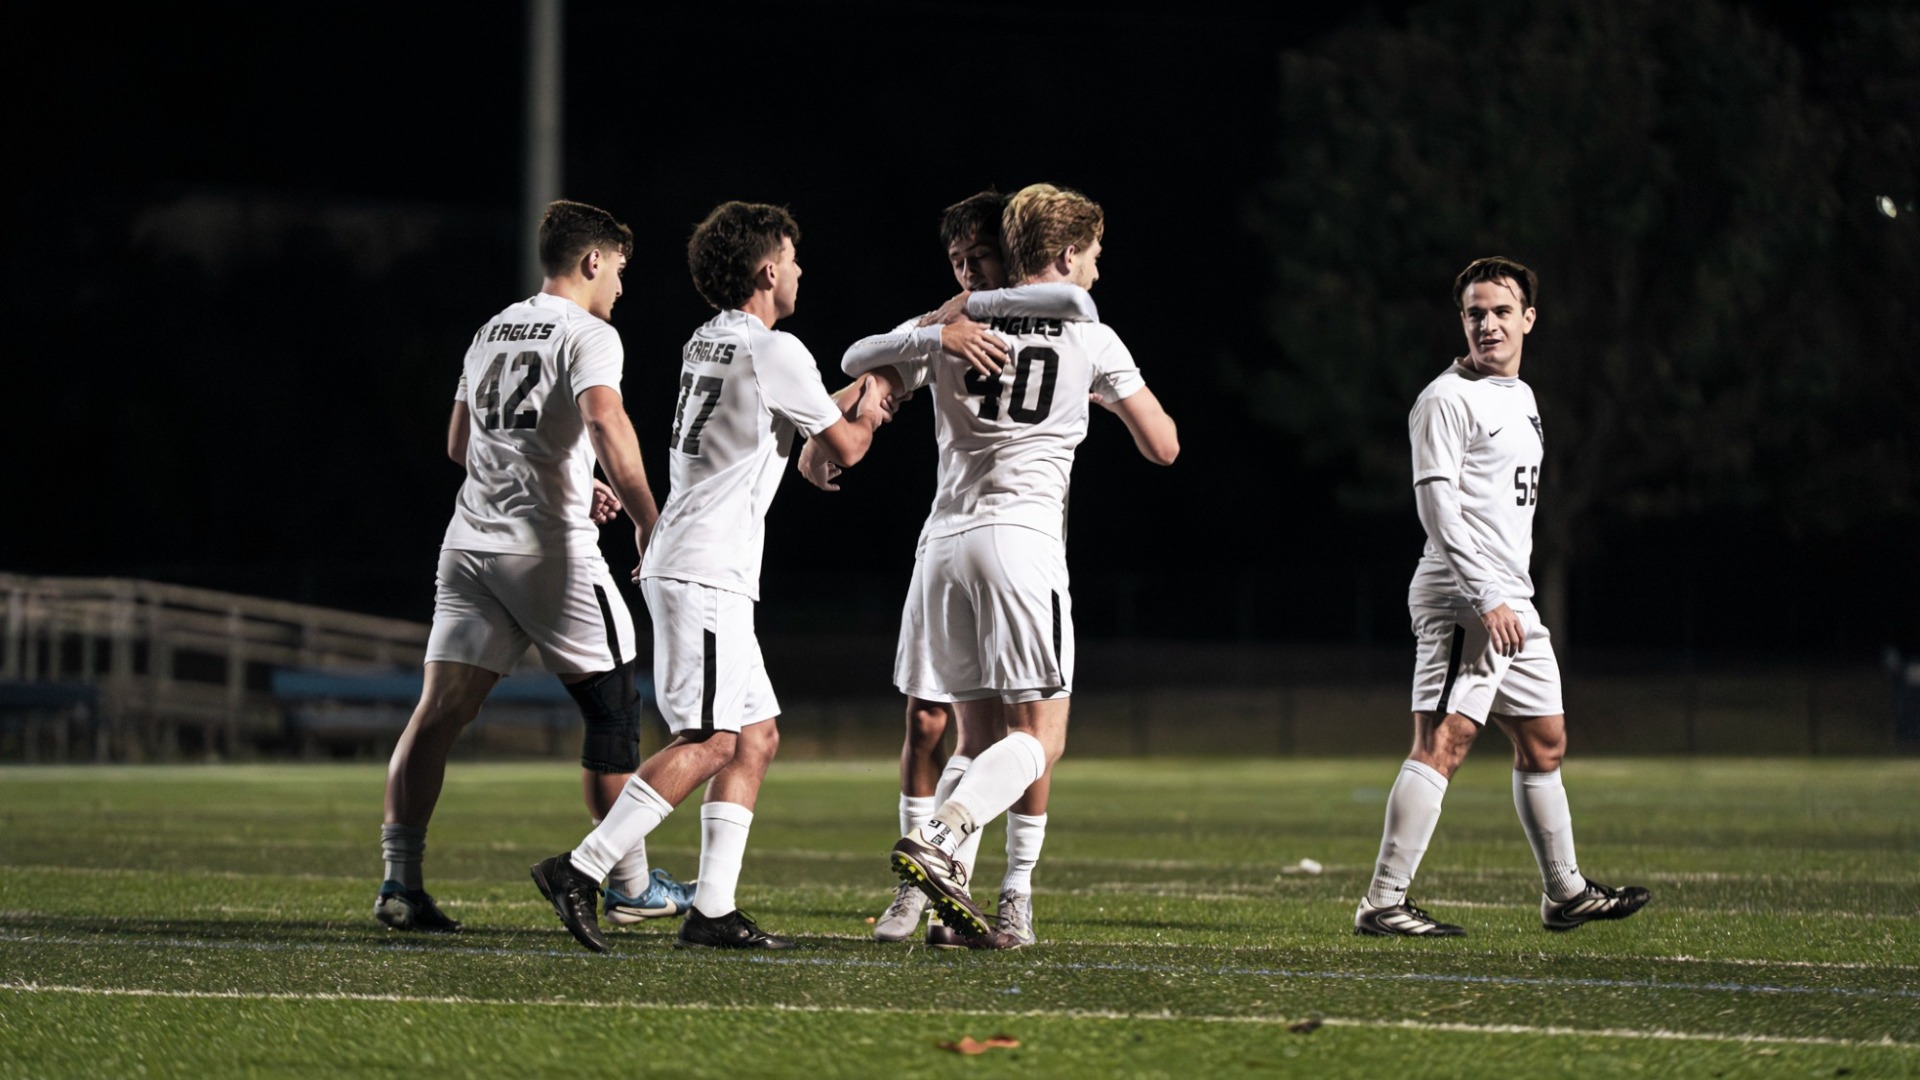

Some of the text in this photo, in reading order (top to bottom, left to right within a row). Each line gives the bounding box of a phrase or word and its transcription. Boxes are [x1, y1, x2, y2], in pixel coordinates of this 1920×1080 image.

[486, 323, 557, 343] EAGLES
[981, 316, 1063, 337] AGLES
[686, 340, 737, 365] EAGLES
[475, 350, 543, 430] 42
[963, 346, 1060, 425] 40
[1514, 465, 1539, 507] 56
